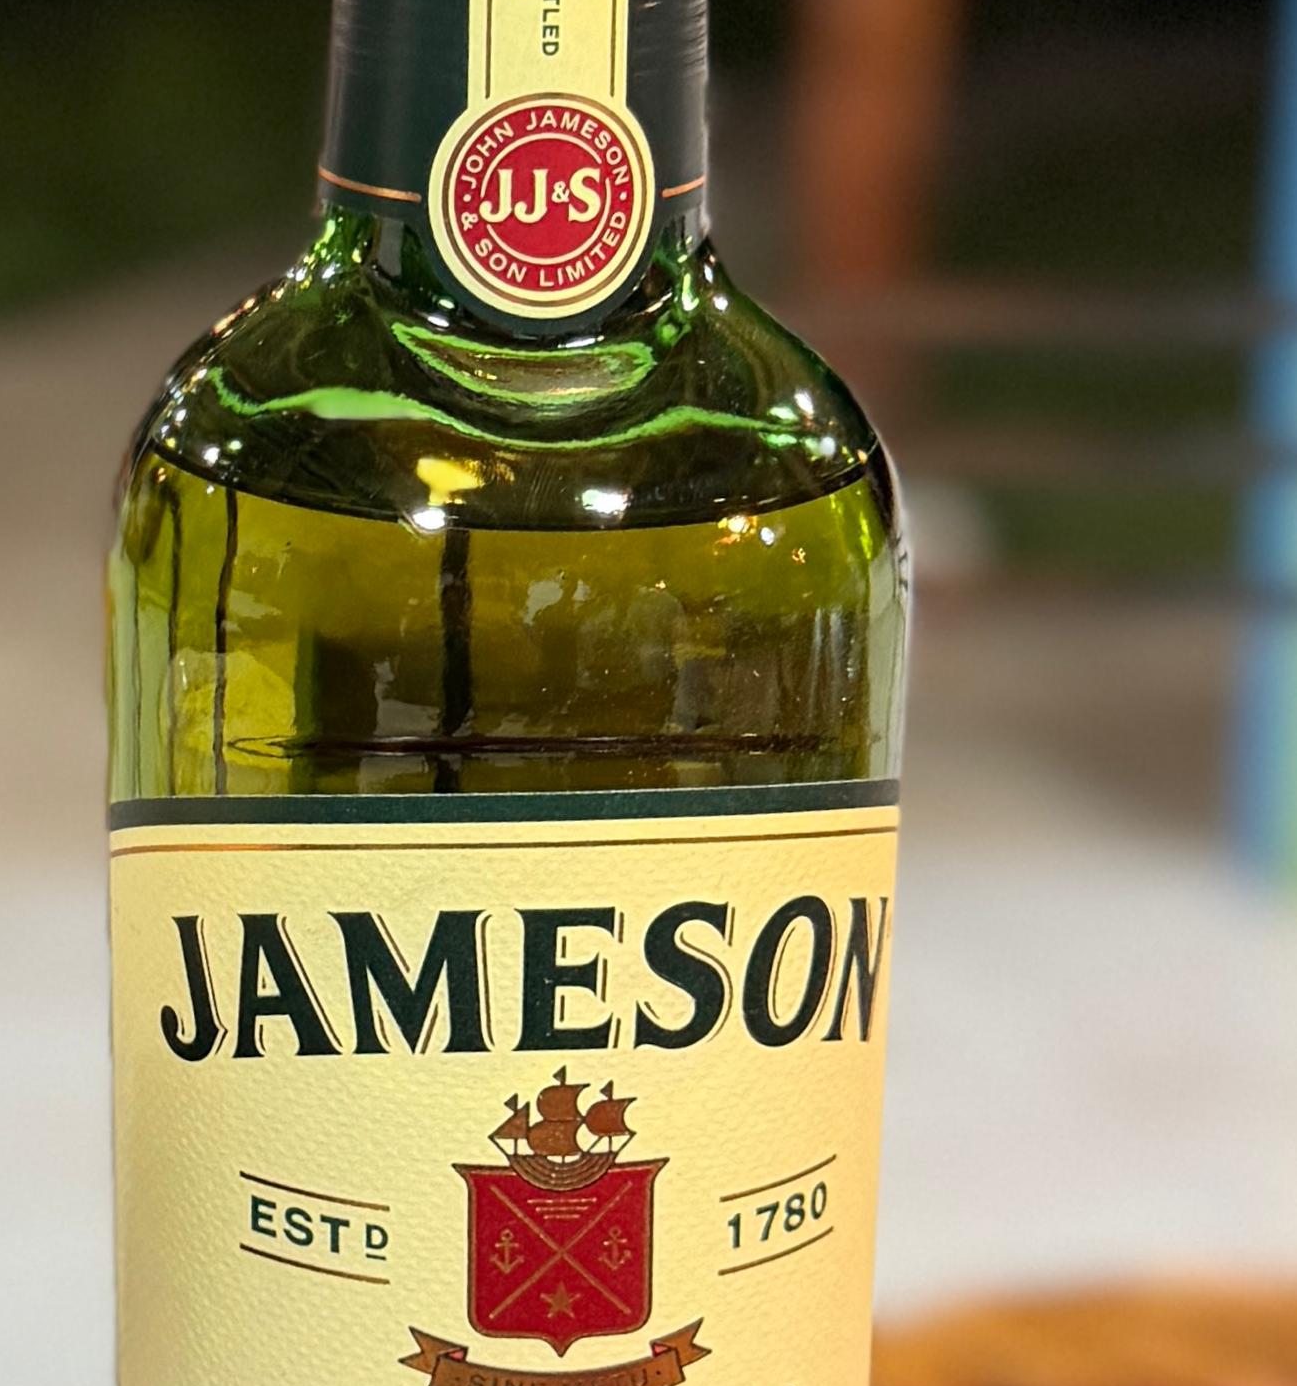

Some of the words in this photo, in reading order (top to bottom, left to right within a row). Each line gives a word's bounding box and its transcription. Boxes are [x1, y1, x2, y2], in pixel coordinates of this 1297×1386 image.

[460, 121, 514, 189] JOHN
[526, 109, 629, 187] JAMESON
[478, 167, 602, 224] JJ&S
[460, 211, 479, 230] &
[474, 238, 527, 284] SON
[539, 211, 626, 287] LIMITED
[159, 894, 889, 1063] JAMESON
[727, 1181, 827, 1249] 1780
